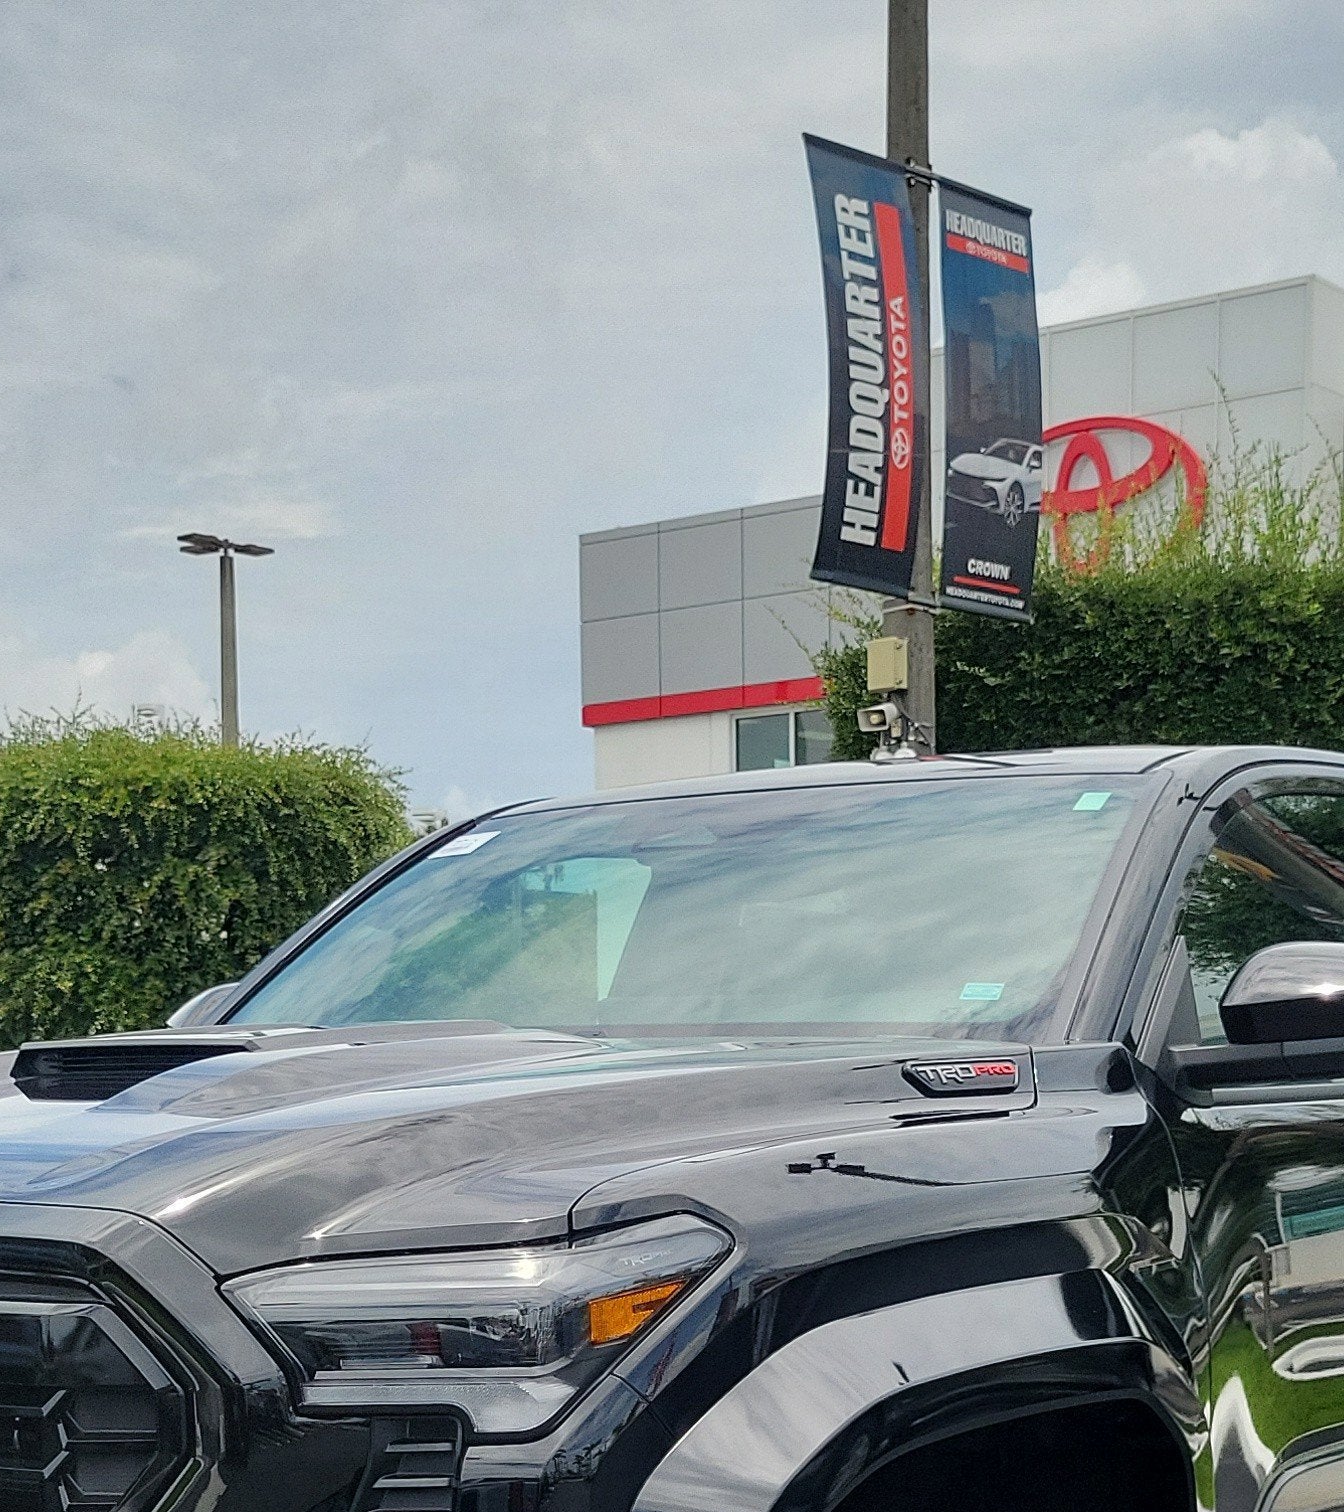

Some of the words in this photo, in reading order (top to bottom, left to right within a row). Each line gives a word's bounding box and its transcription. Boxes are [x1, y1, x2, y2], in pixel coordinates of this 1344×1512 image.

[946, 209, 1027, 257] HEADQUARTER
[976, 245, 1009, 265] TOYOTA
[834, 193, 889, 547] HEADQUARTER
[889, 296, 910, 424] TOYOTA
[967, 558, 1010, 582] CROWN
[916, 1065, 977, 1084] TRD
[973, 1064, 1017, 1077] PRO
